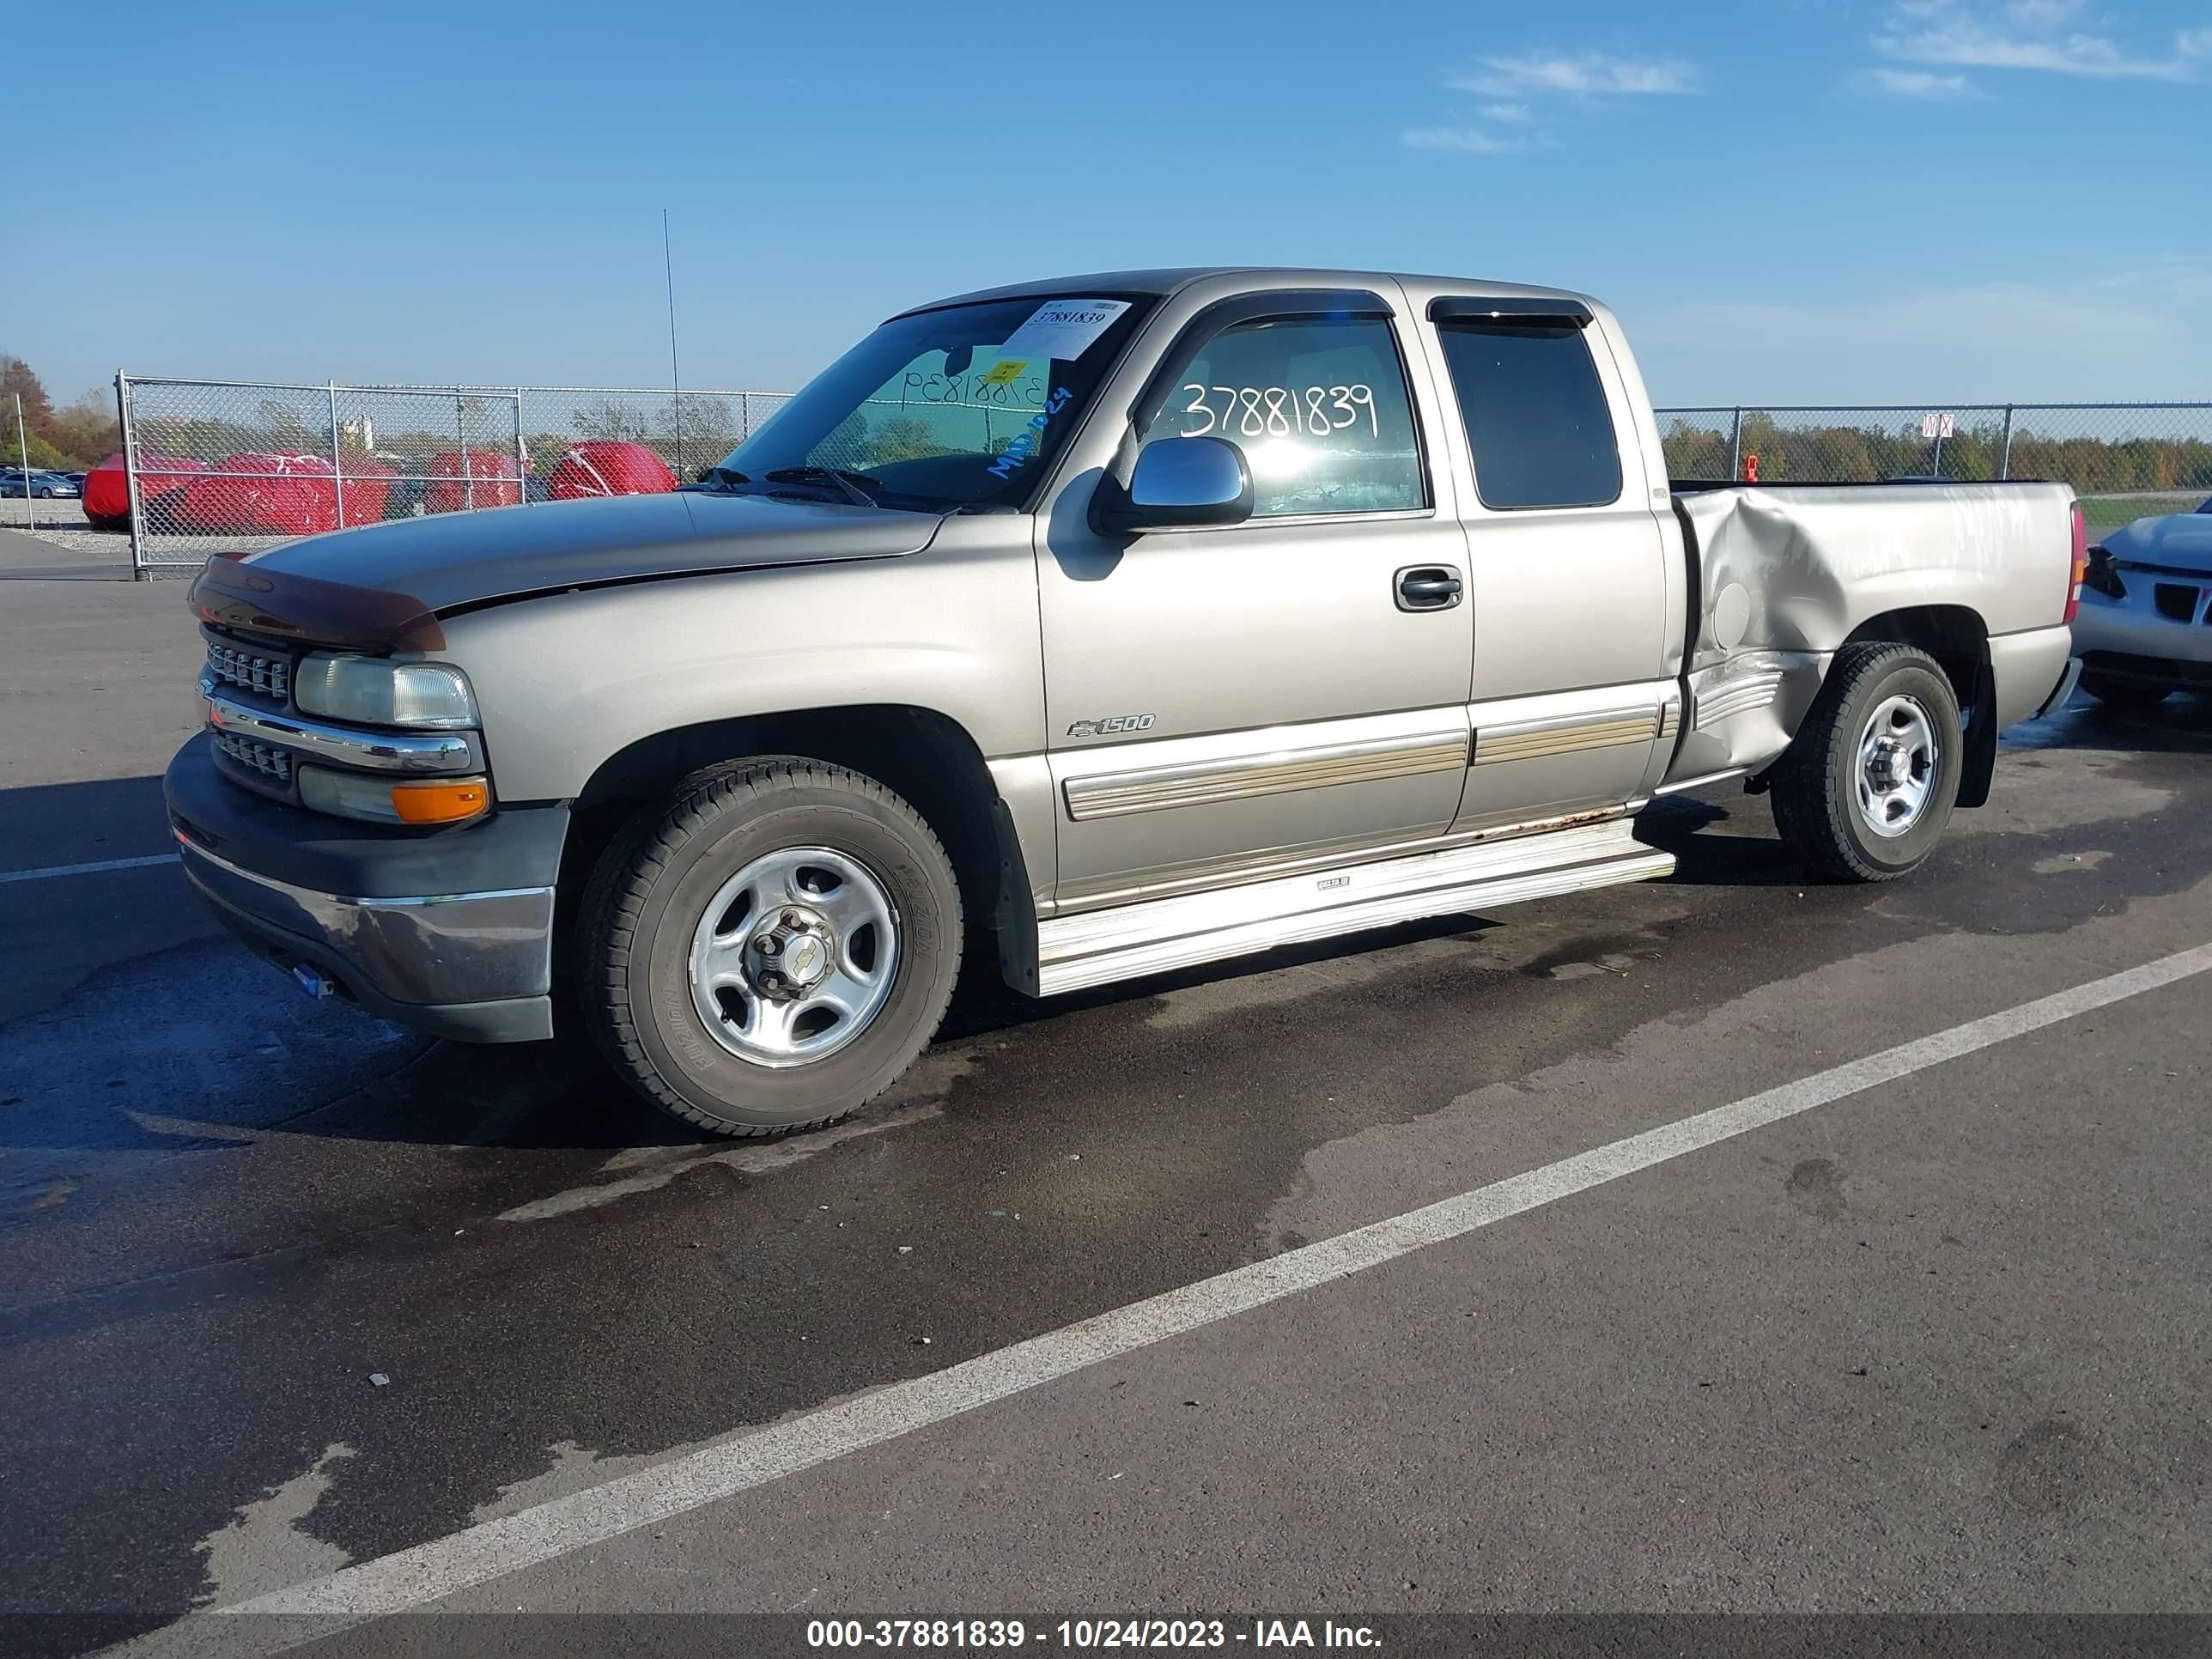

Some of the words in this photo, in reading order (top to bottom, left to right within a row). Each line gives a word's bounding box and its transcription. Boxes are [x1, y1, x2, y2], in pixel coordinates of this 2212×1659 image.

[1034, 311, 1106, 325] 37881839
[1181, 384, 1377, 438] 37881839
[1100, 714, 1156, 734] 1500
[663, 988, 716, 1070] FUZION
